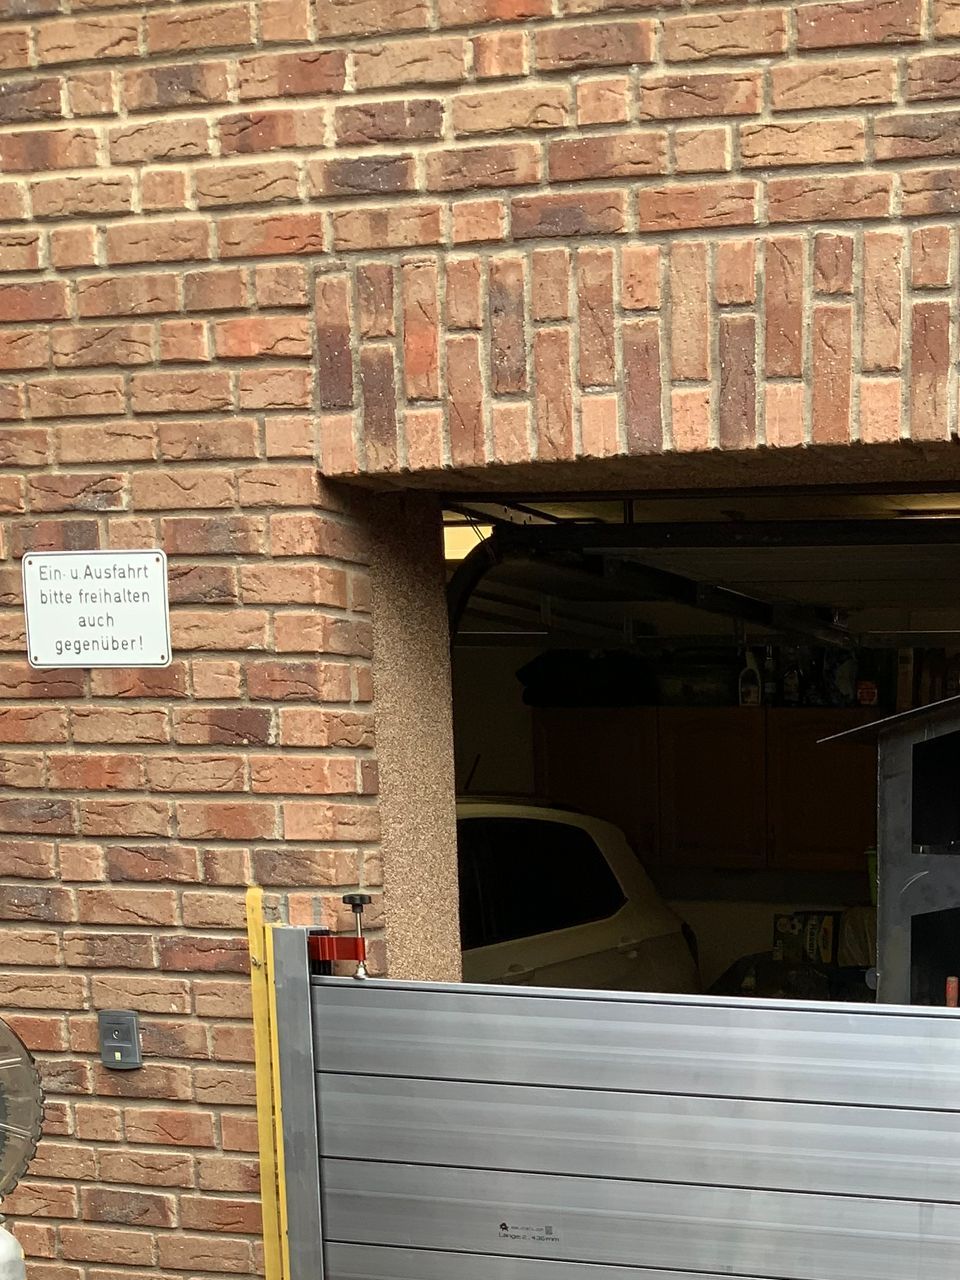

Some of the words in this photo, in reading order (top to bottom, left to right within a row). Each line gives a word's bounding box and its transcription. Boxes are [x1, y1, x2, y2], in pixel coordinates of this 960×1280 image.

[40, 589, 73, 605] bitte
[78, 588, 150, 604] freihalten
[78, 612, 115, 628] auch
[55, 635, 144, 655] gegenüber!
